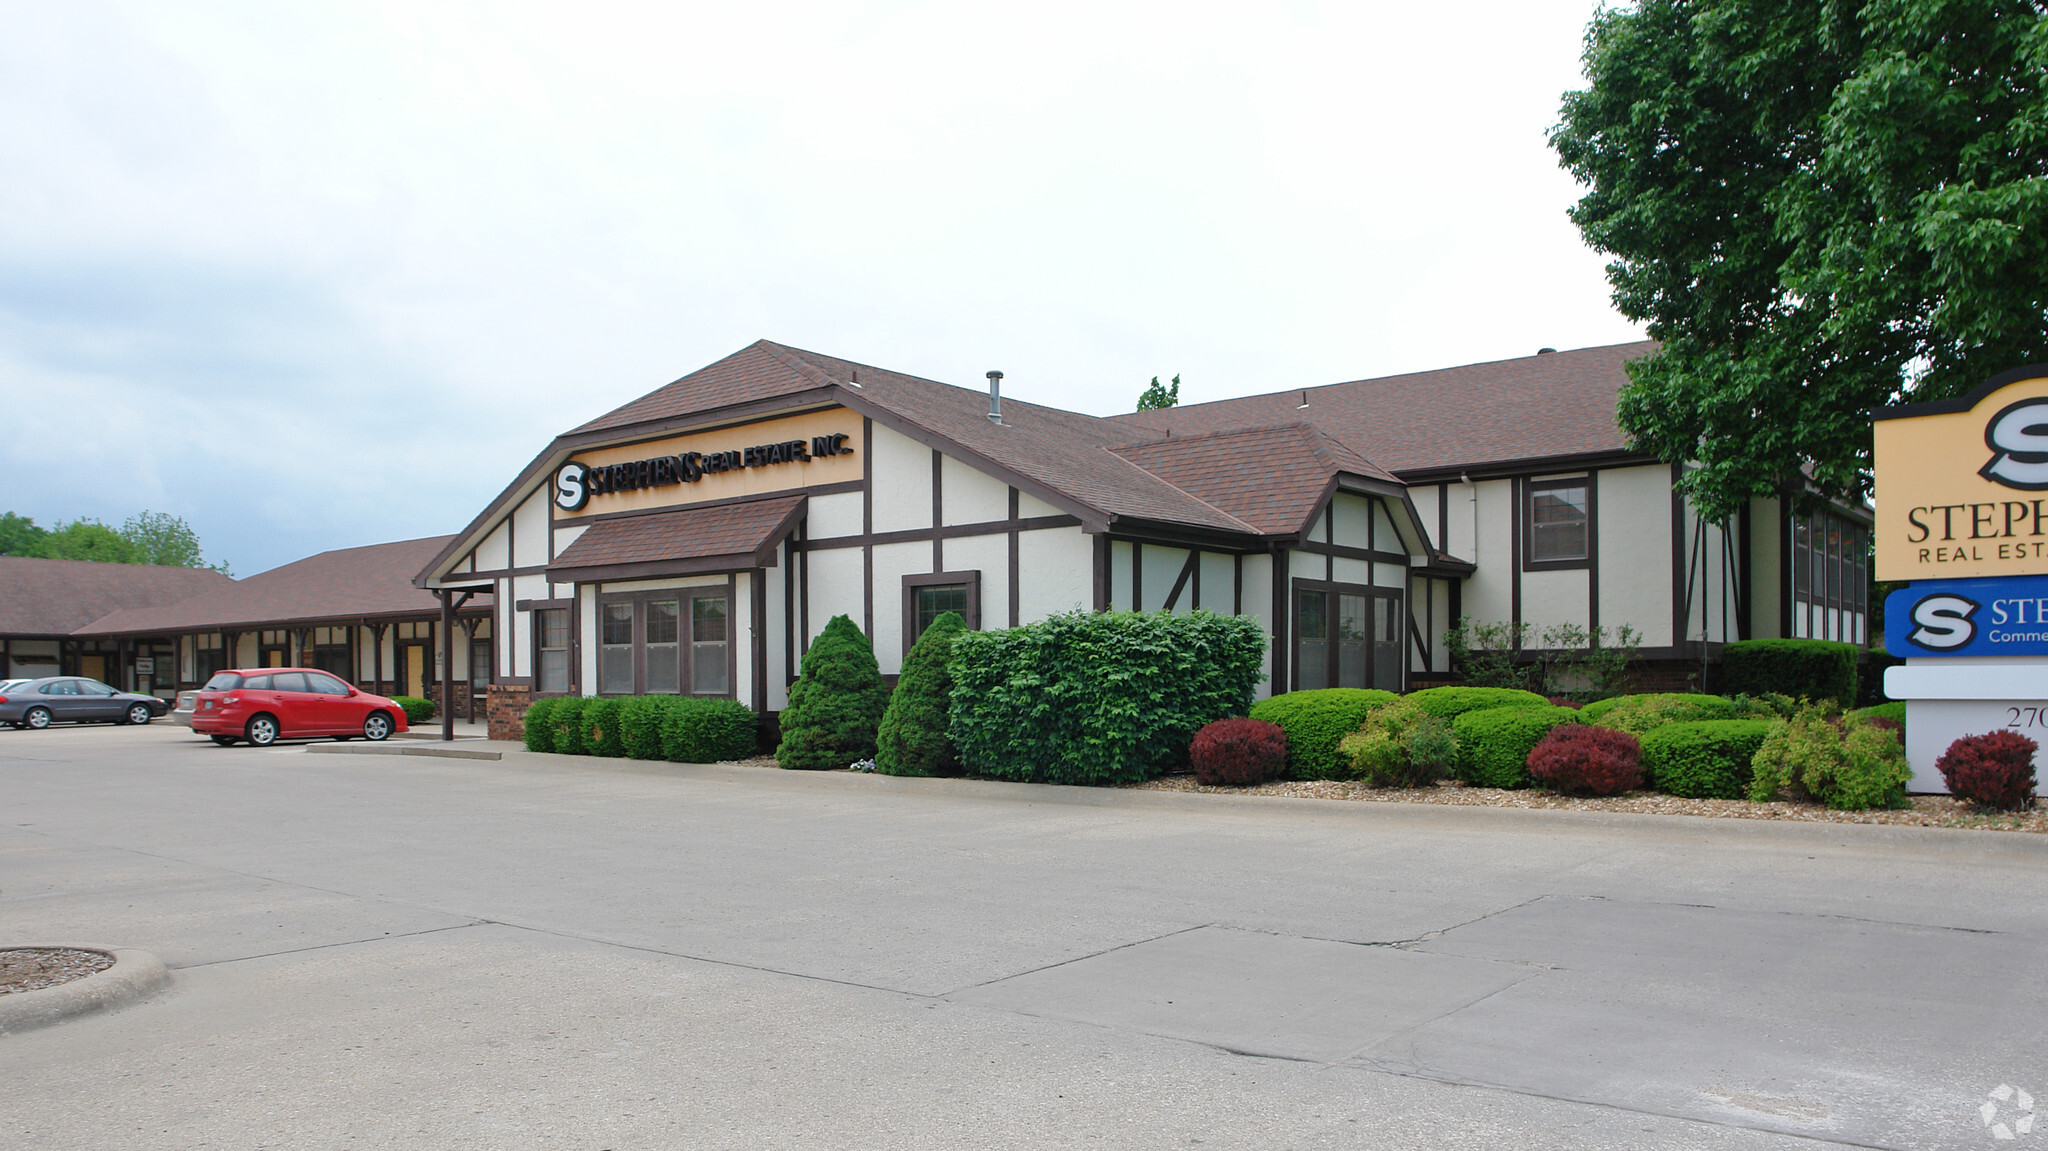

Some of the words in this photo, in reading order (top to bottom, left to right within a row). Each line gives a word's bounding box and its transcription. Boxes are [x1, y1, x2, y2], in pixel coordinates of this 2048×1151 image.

[555, 461, 590, 511] S
[589, 452, 702, 495] STEPHENS
[701, 450, 745, 474] REAL
[744, 440, 811, 467] ESTATE,
[812, 433, 854, 457] INC.
[1919, 546, 1983, 563] REAL
[1998, 542, 2048, 560] EST
[1905, 593, 1982, 652] S
